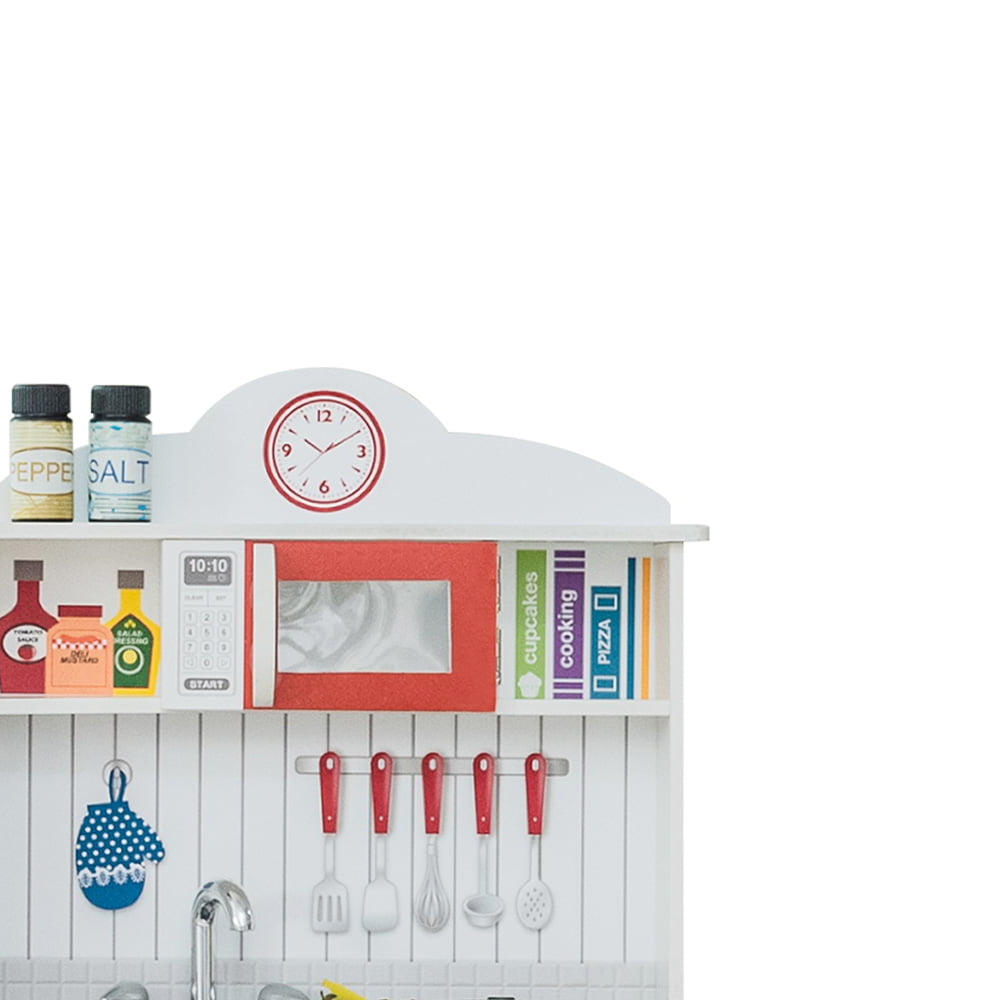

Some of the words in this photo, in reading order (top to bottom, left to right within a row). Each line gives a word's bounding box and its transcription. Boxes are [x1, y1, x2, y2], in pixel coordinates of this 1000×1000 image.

[317, 409, 333, 422] 12
[282, 443, 292, 457] 9
[357, 444, 367, 458] 3
[10, 461, 73, 482] PEPPE
[89, 459, 150, 484] SALT
[319, 480, 330, 494] 6
[189, 558, 228, 573] 10:10
[522, 571, 541, 665] cupcakes
[557, 589, 578, 669] cooking
[597, 619, 611, 664] PIZZA
[189, 680, 224, 689] START
